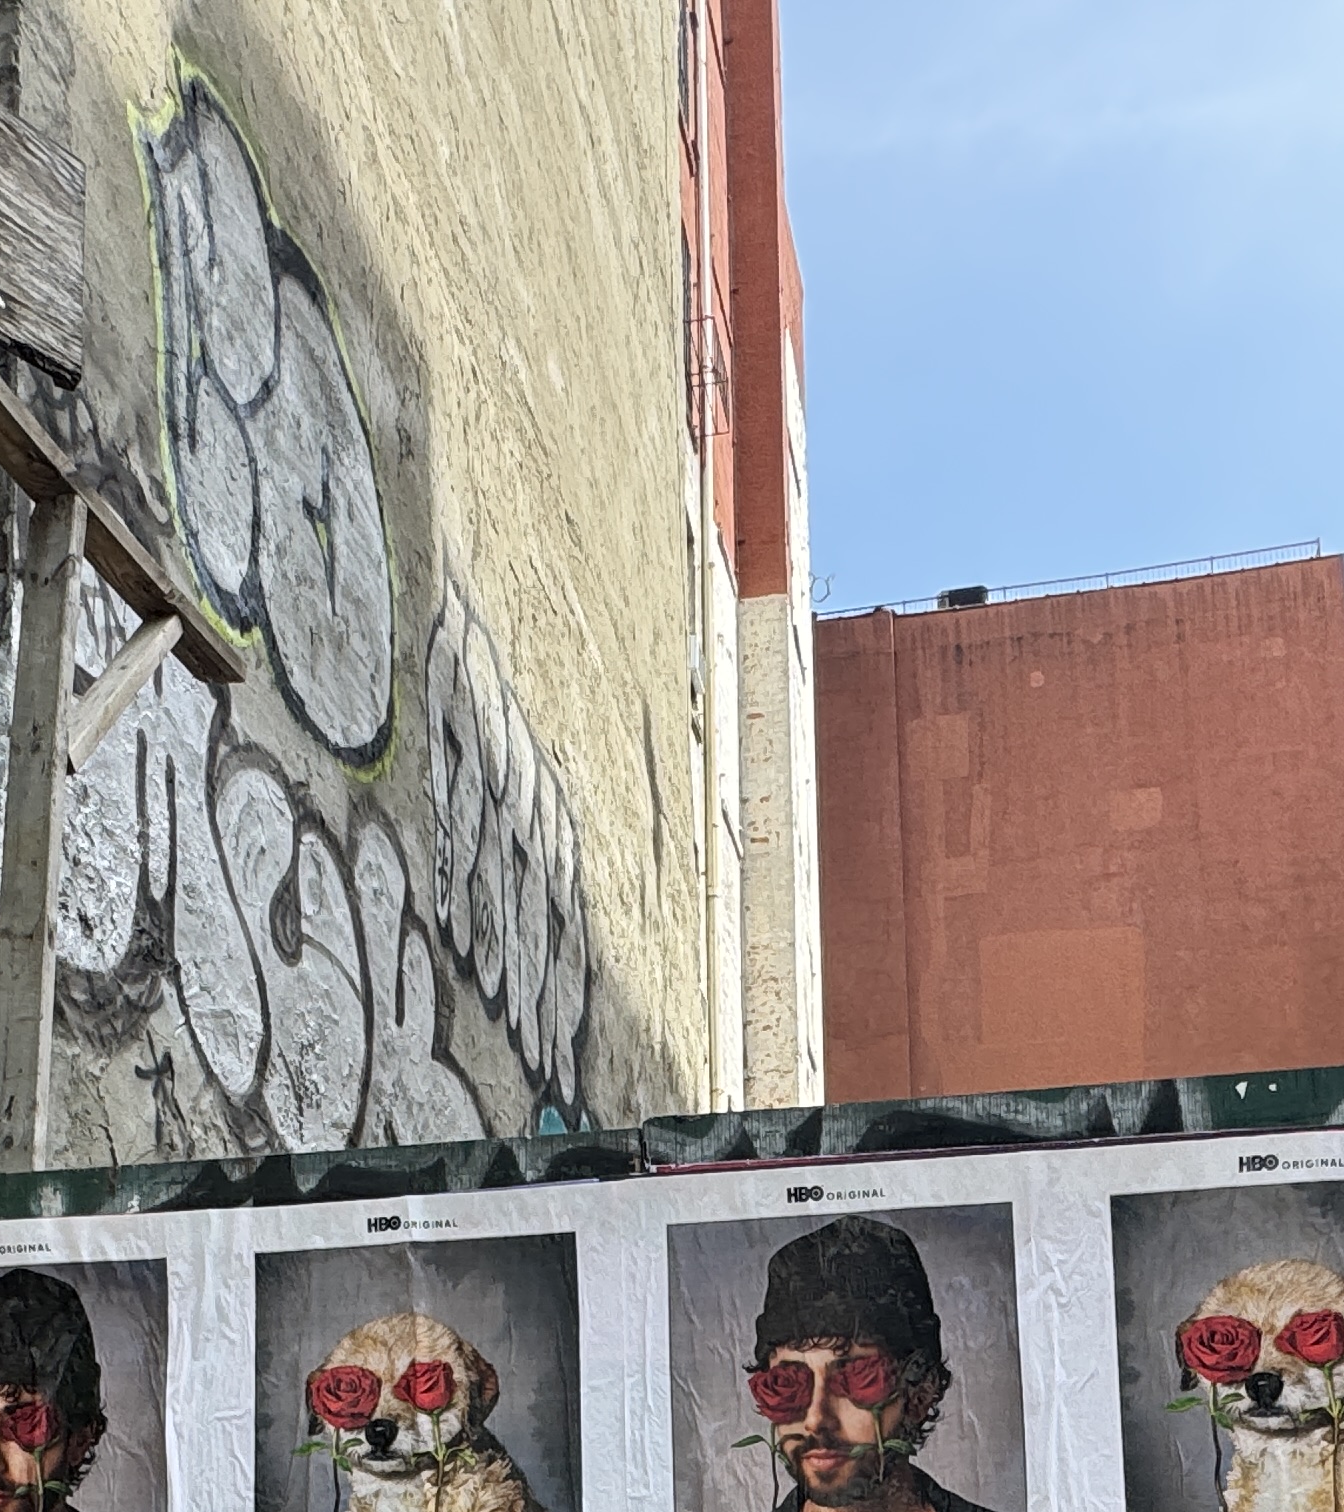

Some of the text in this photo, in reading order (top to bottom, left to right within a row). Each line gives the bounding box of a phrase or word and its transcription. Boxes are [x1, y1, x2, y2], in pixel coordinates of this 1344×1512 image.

[1238, 1154, 1344, 1173] HBO ORIGINAL
[786, 1185, 886, 1203] HBO ORIGINAL
[367, 1215, 458, 1233] HBO ORIGINAL
